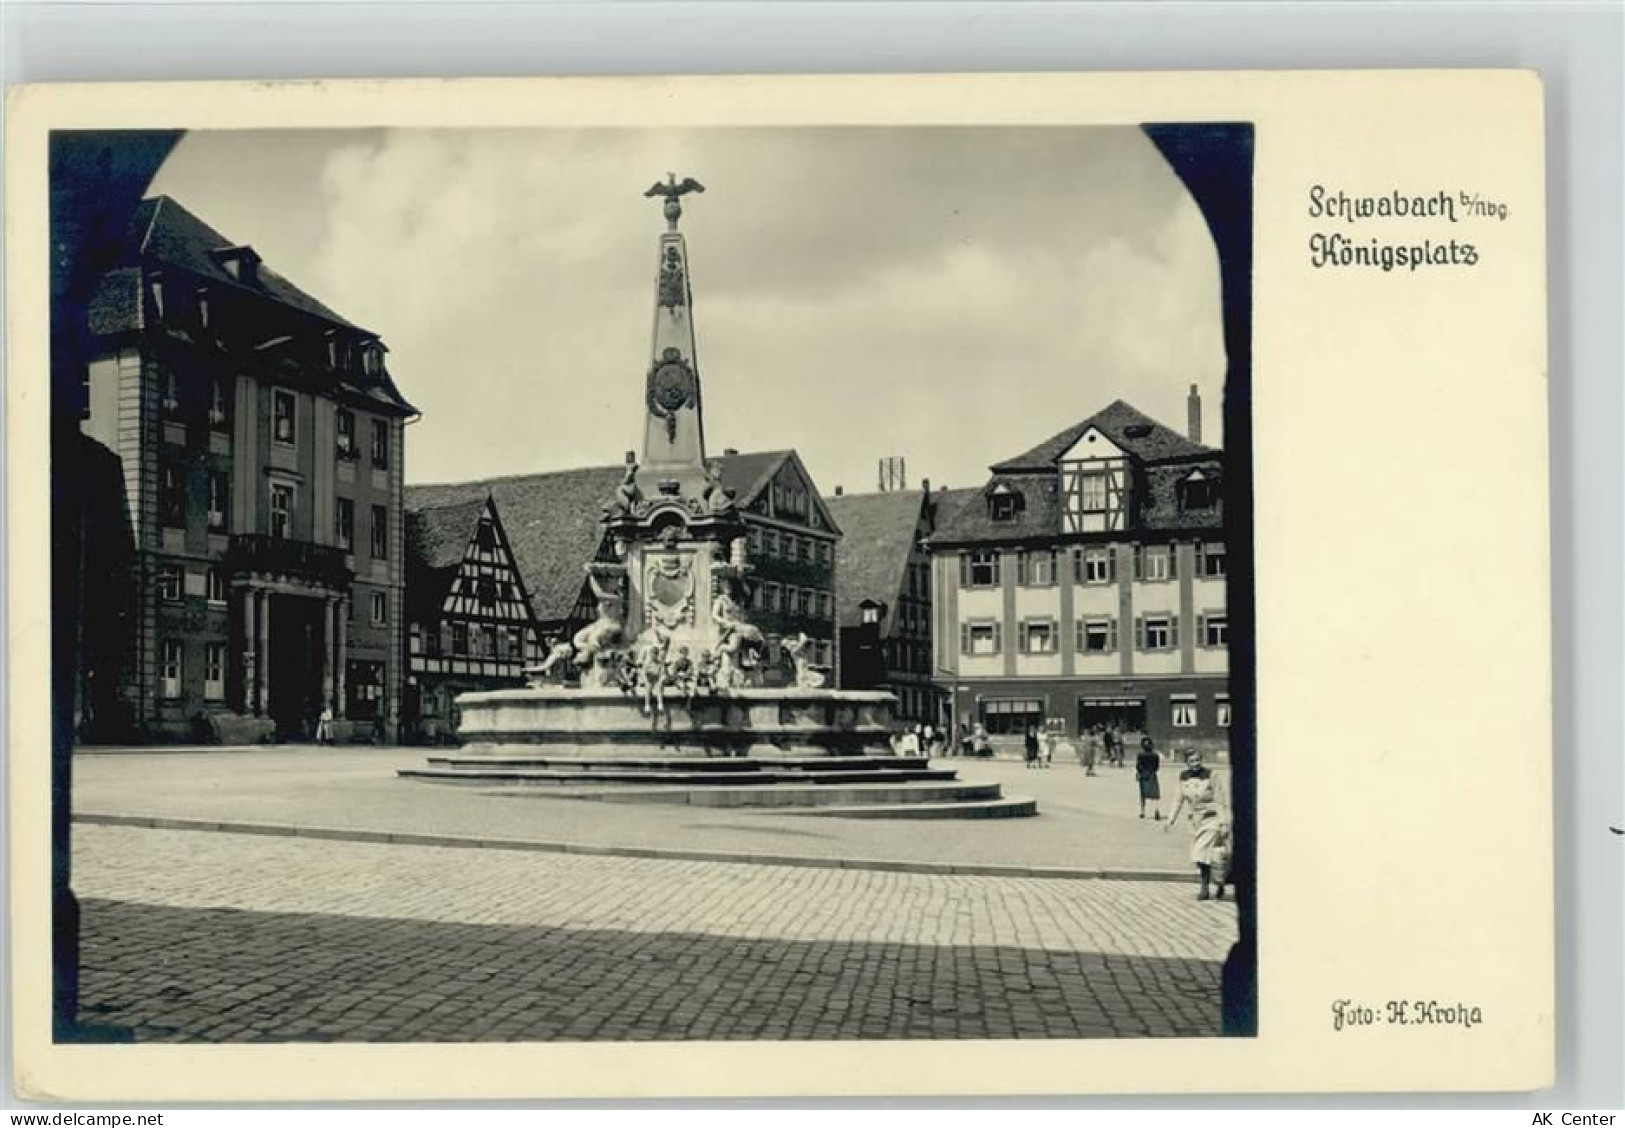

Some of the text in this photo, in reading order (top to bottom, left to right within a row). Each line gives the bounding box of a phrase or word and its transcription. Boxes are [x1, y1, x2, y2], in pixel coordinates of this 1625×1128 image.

[1308, 184, 1457, 223] Schwabach
[1308, 233, 1479, 272] Königsplatz
[1331, 999, 1381, 1031] Foto:
